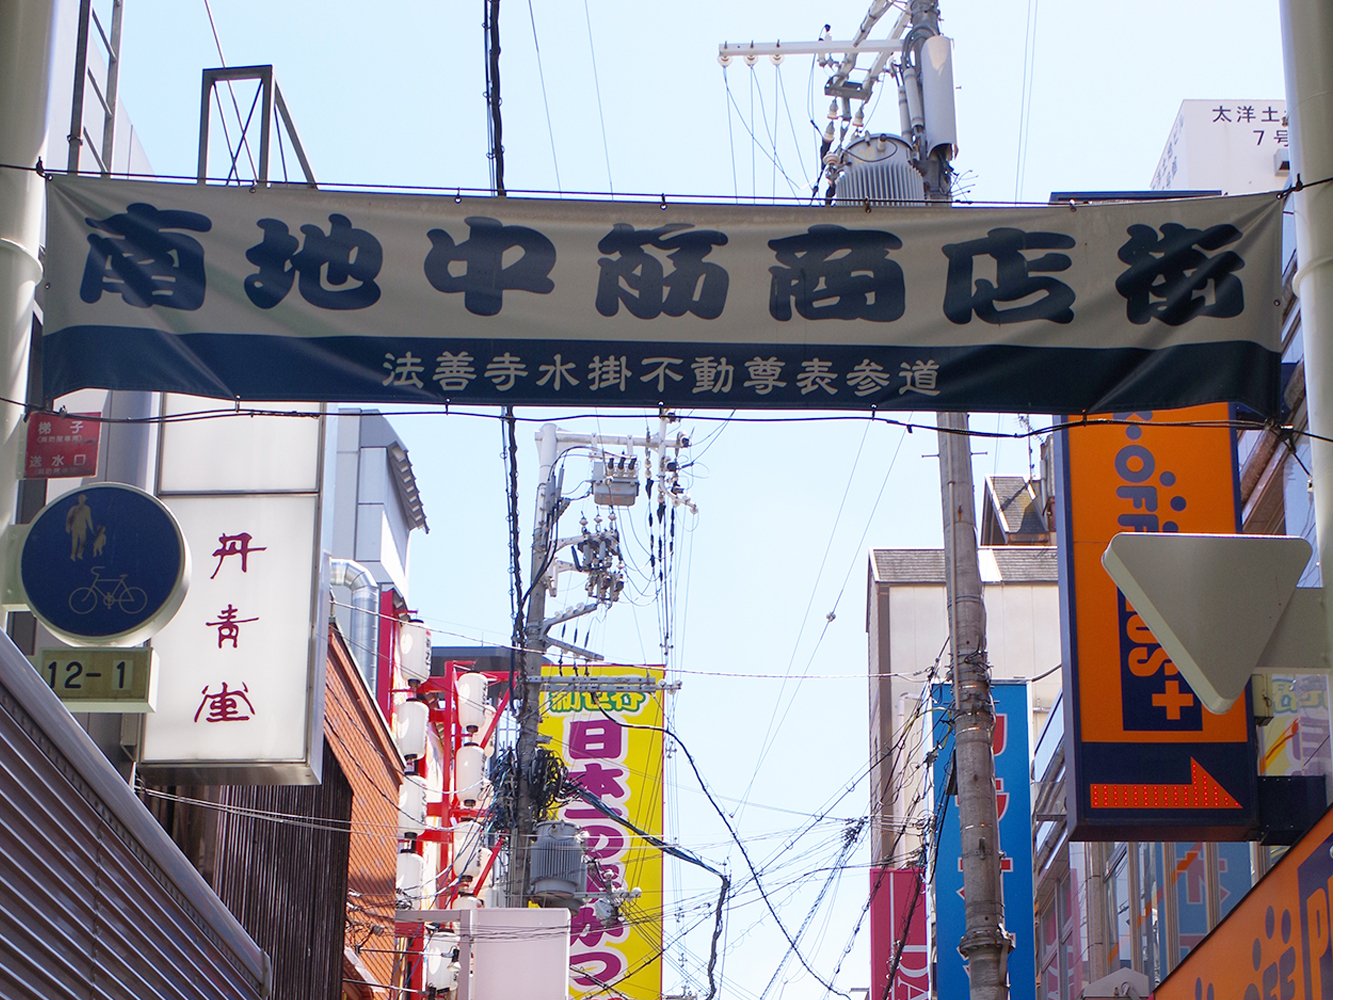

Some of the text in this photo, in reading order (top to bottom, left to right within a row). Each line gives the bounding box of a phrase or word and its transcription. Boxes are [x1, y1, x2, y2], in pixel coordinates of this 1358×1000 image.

[1212, 105, 1287, 123] 太洋土
[79, 202, 1244, 325] 南地中筋商店街
[382, 350, 941, 397] 法善寺水掛不動尊表参道
[30, 454, 86, 467] 送水口
